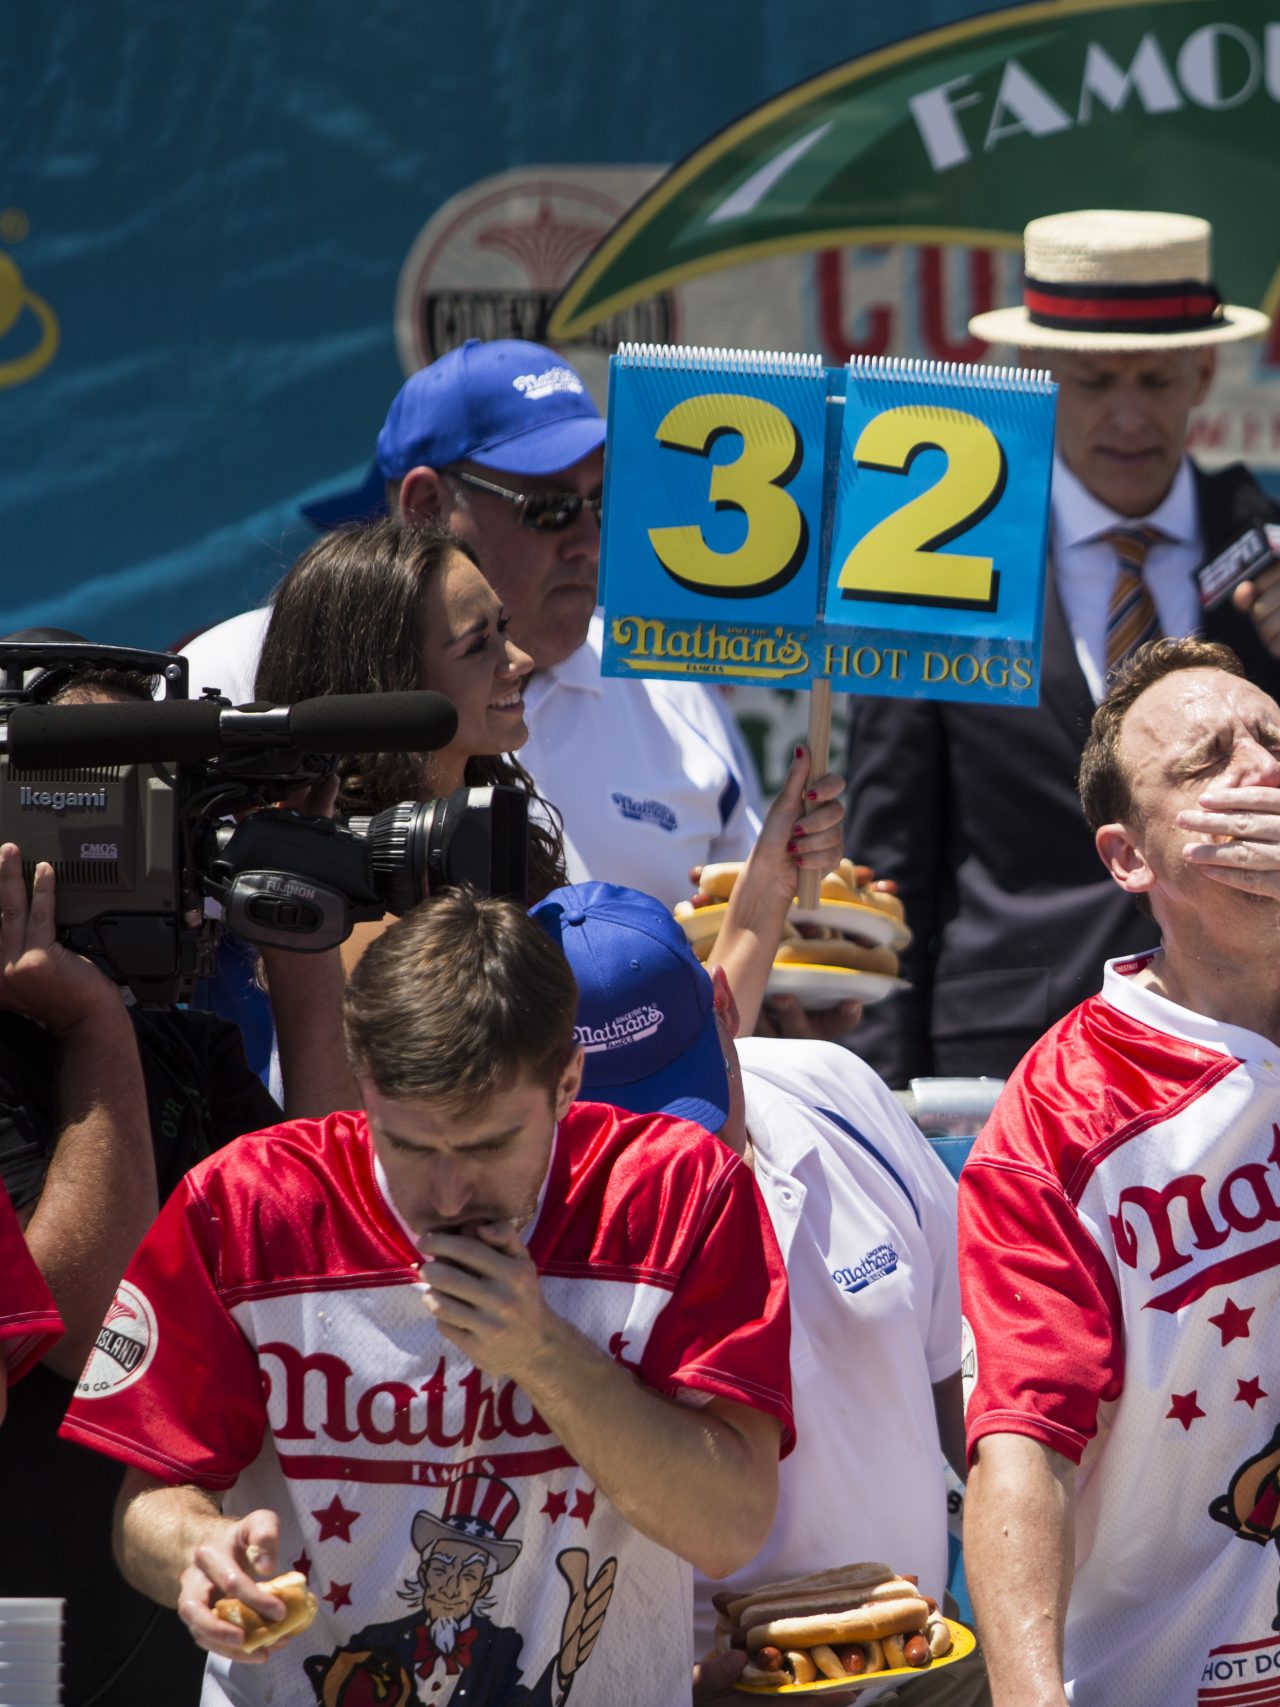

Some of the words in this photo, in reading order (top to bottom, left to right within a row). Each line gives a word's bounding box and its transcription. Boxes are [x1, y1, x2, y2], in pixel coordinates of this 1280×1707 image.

[647, 392, 1008, 613] 32
[612, 616, 804, 665] Nathan's
[823, 644, 909, 682] HOT
[921, 651, 1033, 690] DOGS
[20, 787, 106, 810] Ikegami
[80, 843, 118, 855] CMOS
[266, 880, 316, 899] FUJINON
[572, 1005, 660, 1044] Nathan's
[95, 1328, 141, 1370] ISLAND
[1201, 1658, 1248, 1682] HOT
